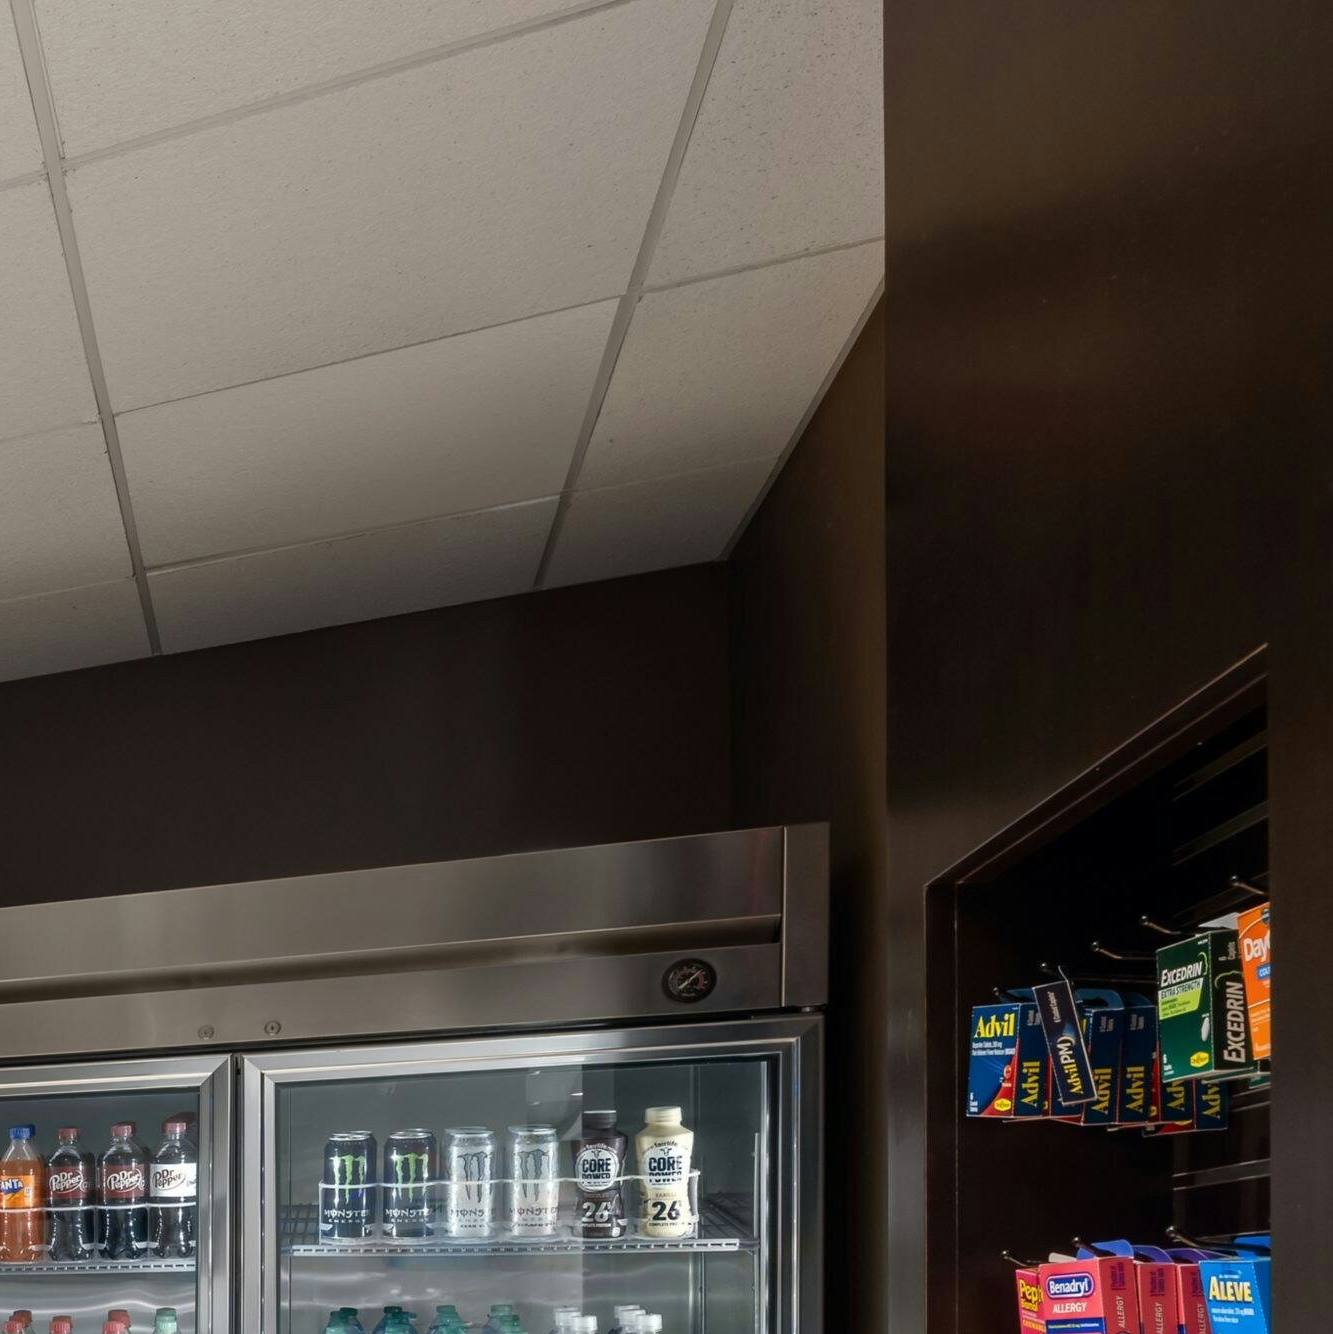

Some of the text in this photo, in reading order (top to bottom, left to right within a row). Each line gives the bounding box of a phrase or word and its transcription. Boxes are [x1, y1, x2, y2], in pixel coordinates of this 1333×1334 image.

[1161, 961, 1203, 987] EXCEDRIN
[1161, 980, 1201, 999] EXTRA STRENGTH
[974, 1013, 1015, 1038] Advil
[1223, 982, 1245, 1063] EXCEDRIN
[1021, 1061, 1040, 1108] Advil
[1064, 1064, 1083, 1094] Advil
[1126, 1066, 1144, 1113] Advil
[1092, 1068, 1112, 1115] Advil
[162, 1169, 174, 1178] Dr
[582, 1158, 611, 1173] CORE
[648, 1155, 683, 1172] CORE
[50, 1175, 81, 1191] Pepper
[59, 1172, 71, 1182] Dr
[121, 1171, 133, 1181] Dr
[152, 1172, 183, 1188] Pepper
[582, 1202, 609, 1223] 26
[652, 1201, 680, 1221] 26
[1049, 1275, 1091, 1296] Benadryl
[1209, 1276, 1253, 1302] ALEVE
[1053, 1302, 1087, 1314] ALLERGY
[1118, 1295, 1126, 1328] ALLERGY
[1156, 1302, 1164, 1334] ALLERGY
